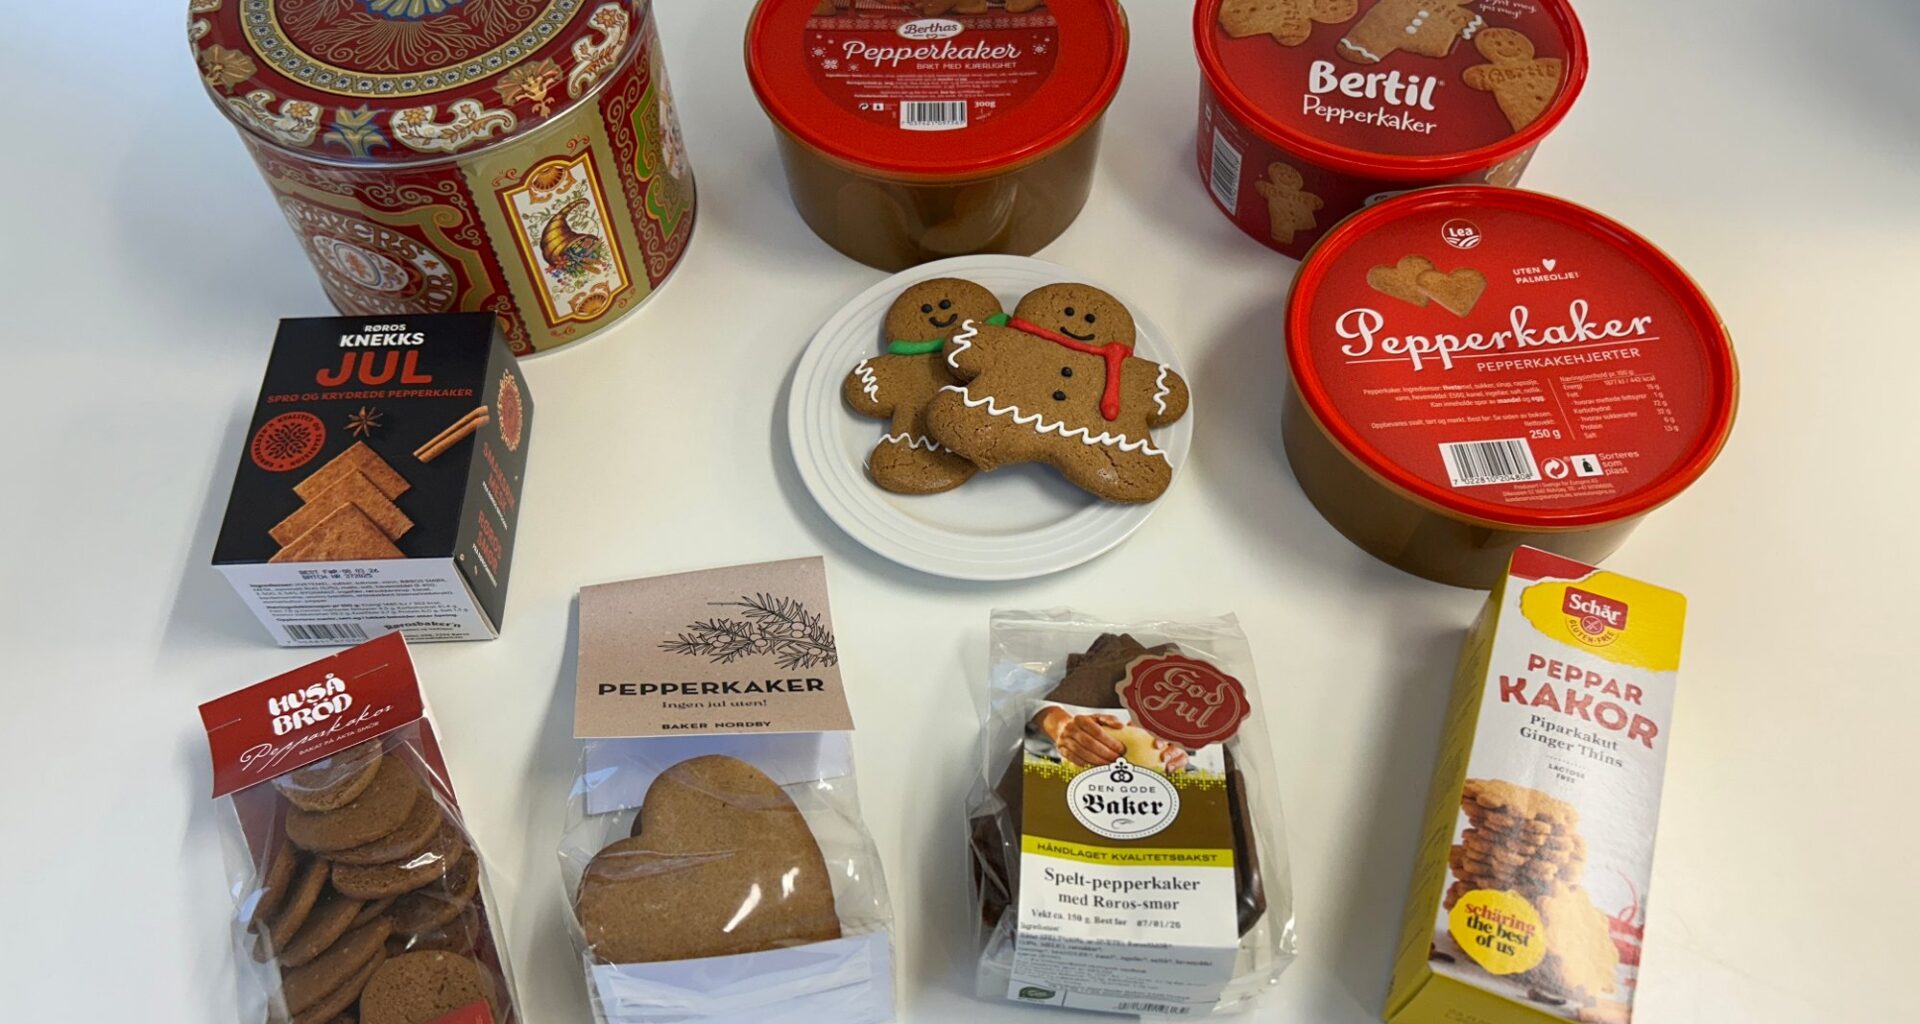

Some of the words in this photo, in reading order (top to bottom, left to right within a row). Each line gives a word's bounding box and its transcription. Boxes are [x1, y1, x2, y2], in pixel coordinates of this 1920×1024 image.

[904, 22, 957, 34] Berthas
[843, 40, 1021, 67] Pepperkaker
[1308, 60, 1438, 111] Bertil
[1303, 94, 1437, 135] Pepperkaker
[1449, 227, 1474, 238] Lea
[1512, 266, 1541, 276] UTEN
[1515, 271, 1580, 285] PALMEOLJE!
[364, 323, 407, 332] RØROS
[1334, 299, 1652, 372] Pepperkaker
[340, 332, 425, 347] KNEKKS
[316, 350, 433, 387] JUL
[1477, 347, 1641, 373] PEPPERKAKEHJERTER
[267, 394, 299, 403] SPRØ
[302, 393, 319, 401] OG
[322, 390, 385, 400] KRYDREDE
[388, 387, 473, 398] PEPPERKAKER
[1529, 429, 1550, 440] 250
[1552, 430, 1562, 441] g
[1599, 451, 1640, 460] Sorteres
[1602, 460, 1623, 468] som
[1605, 467, 1629, 476] plast
[1569, 593, 1622, 625] Schär
[1569, 619, 1616, 644] GLUTEN-FREE
[599, 678, 825, 696] PEPPERKAKER
[1163, 667, 1231, 706] God
[1527, 653, 1644, 706] PEPPAR
[268, 673, 346, 716] HUSÅ
[662, 700, 706, 710] Ingen
[708, 700, 727, 710] jul
[730, 699, 768, 708] uten!
[1143, 679, 1221, 729] Jul
[272, 693, 353, 736] BRÖD
[1499, 675, 1659, 749] KAKOR
[662, 722, 708, 730] BAKER
[715, 721, 772, 729] NORDBY
[1530, 713, 1620, 751] Piparkakut
[240, 704, 395, 774] Pepparkakor
[1520, 726, 1575, 753] Ginger
[1578, 743, 1624, 769] Thins
[1548, 763, 1586, 780] LACTOSE
[1556, 772, 1576, 784] FREE
[1088, 783, 1115, 793] DEN
[1120, 784, 1157, 794] GODE
[1082, 794, 1164, 816] Baker
[1036, 842, 1107, 860] HÅNDLAGET
[1111, 853, 1219, 862] KVALITETSBAKST
[1044, 866, 1201, 892] Spelt-pepperkaker
[1058, 891, 1089, 906] med
[1093, 896, 1180, 911] Røros-smør
[1031, 908, 1052, 918] Vekt
[1053, 911, 1064, 920] ca.
[1067, 911, 1082, 922] 150
[1094, 915, 1112, 925] Best
[1136, 919, 1181, 929] 07/01/26
[1465, 902, 1536, 936] schäring
[1466, 915, 1493, 933] the
[1496, 922, 1531, 947] best
[1476, 933, 1494, 948] of
[1496, 942, 1516, 957] us
